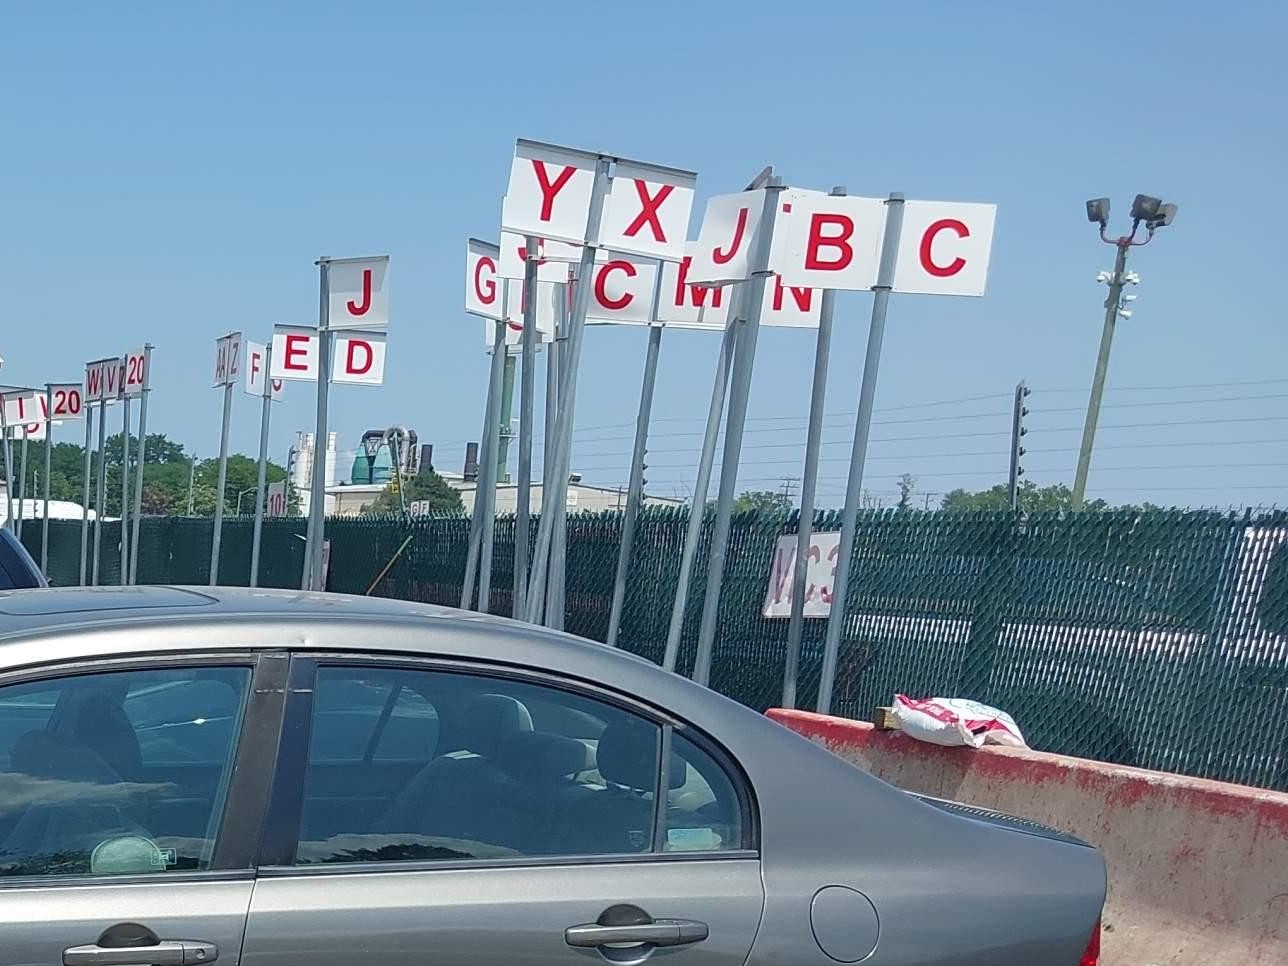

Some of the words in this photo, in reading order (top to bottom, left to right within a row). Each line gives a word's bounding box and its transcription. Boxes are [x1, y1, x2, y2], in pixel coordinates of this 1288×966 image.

[531, 159, 578, 222] Y
[623, 178, 675, 244] X
[712, 207, 749, 265] J
[804, 212, 855, 271] B
[919, 218, 971, 278] C
[347, 269, 372, 316] J
[474, 256, 497, 305] G
[594, 260, 637, 310] C
[127, 356, 145, 385] 20
[251, 352, 260, 384] F
[284, 335, 310, 371] E
[345, 340, 374, 375] D
[87, 368, 100, 396] W
[107, 365, 116, 392] V
[54, 390, 80, 415] 20
